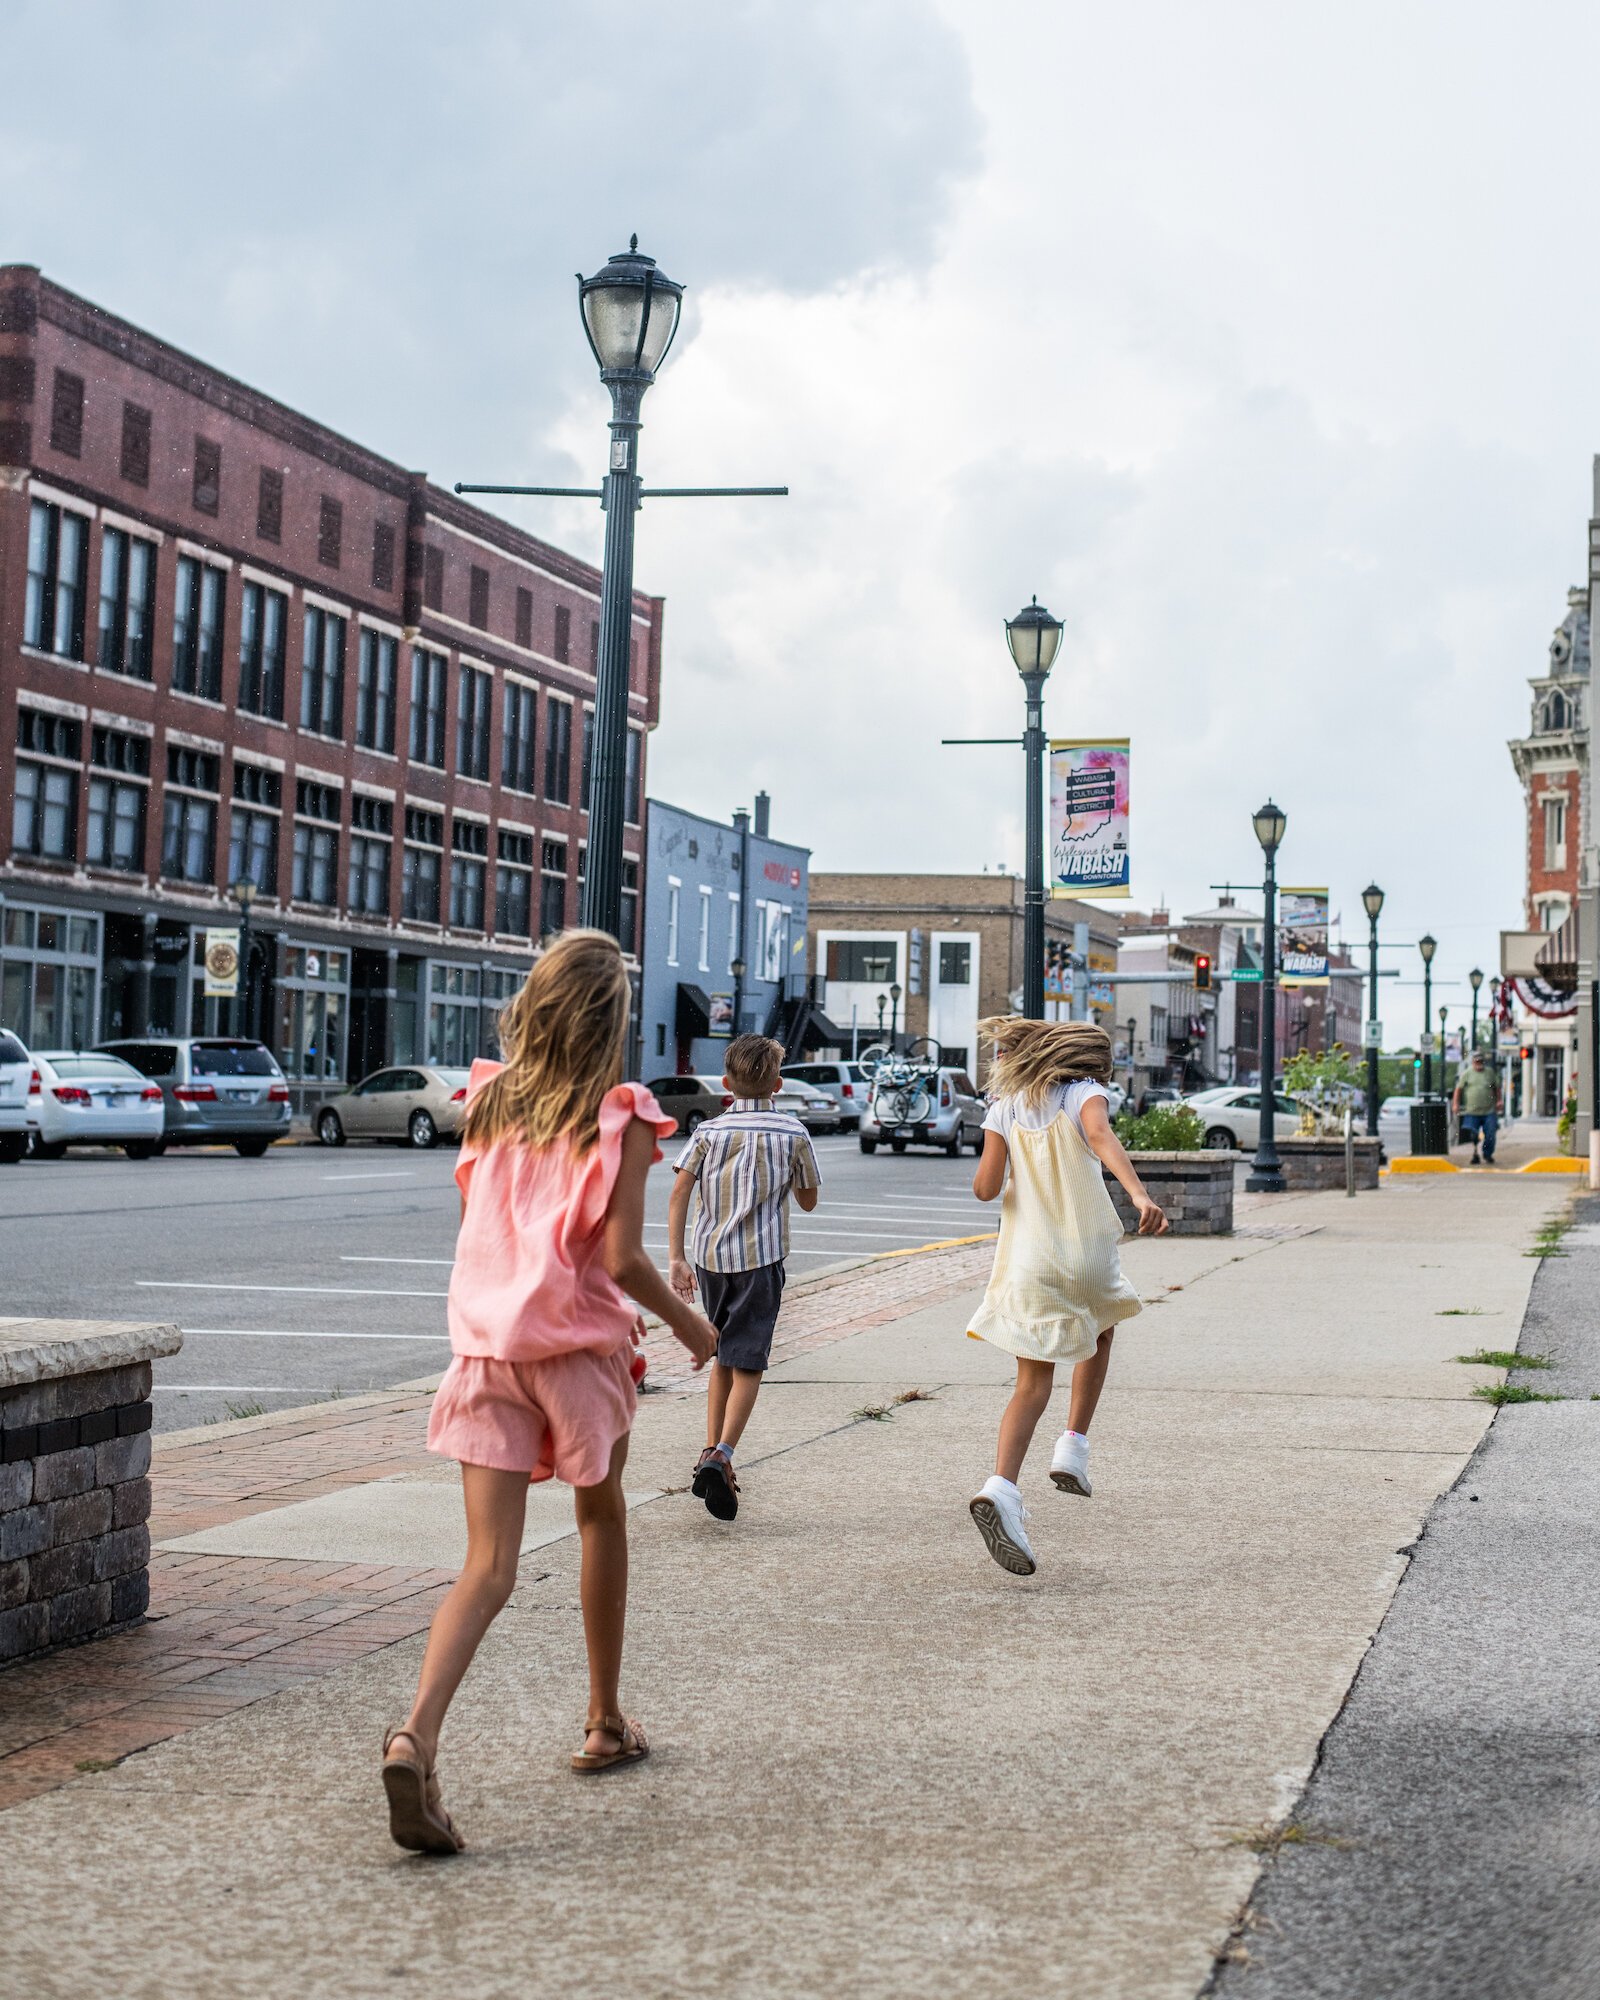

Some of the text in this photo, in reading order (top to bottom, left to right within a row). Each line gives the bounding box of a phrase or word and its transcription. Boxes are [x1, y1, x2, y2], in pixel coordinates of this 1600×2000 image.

[1074, 774, 1107, 783] WABASH
[1072, 788, 1108, 798] CULTURAL
[1074, 802, 1107, 811] DISTRICT
[1053, 844, 1098, 858] Welcome
[1100, 844, 1110, 854] to
[1059, 853, 1125, 876] WABASH
[1083, 872, 1122, 880] DOWNTOWN
[1283, 956, 1327, 971] WABASH
